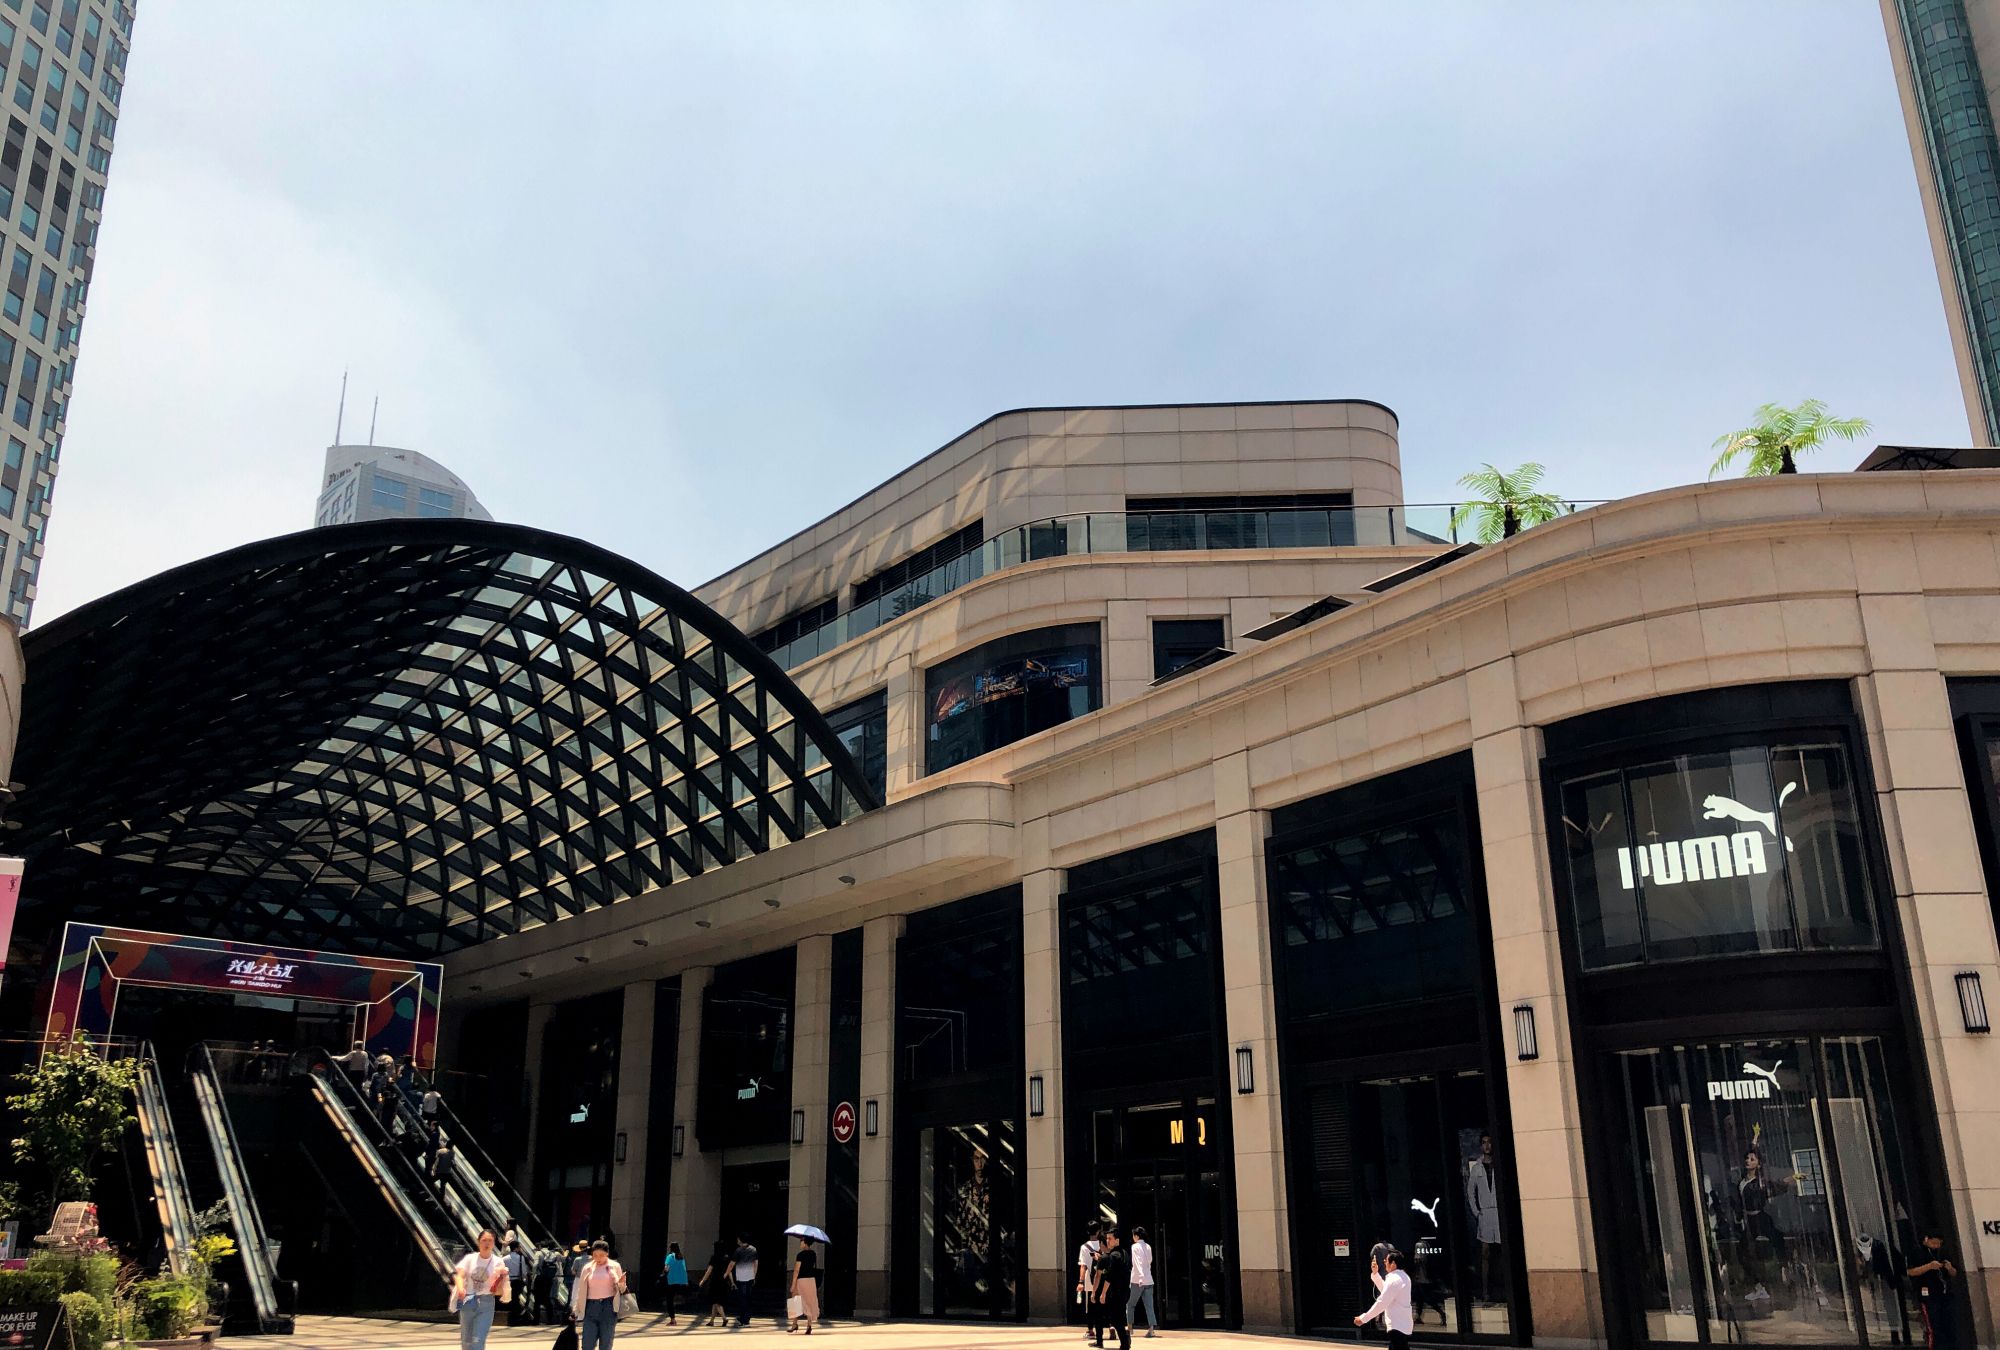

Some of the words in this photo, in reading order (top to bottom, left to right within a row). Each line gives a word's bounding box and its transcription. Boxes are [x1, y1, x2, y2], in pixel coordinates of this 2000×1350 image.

[1618, 831, 1767, 889] PUMA
[227, 960, 299, 978] 兴业太古汇
[1707, 1080, 1770, 1100] PUMA
[0, 1313, 25, 1321] MAKE
[27, 1312, 38, 1320] UP
[0, 1323, 15, 1331] FOR
[17, 1322, 36, 1330] EVER
